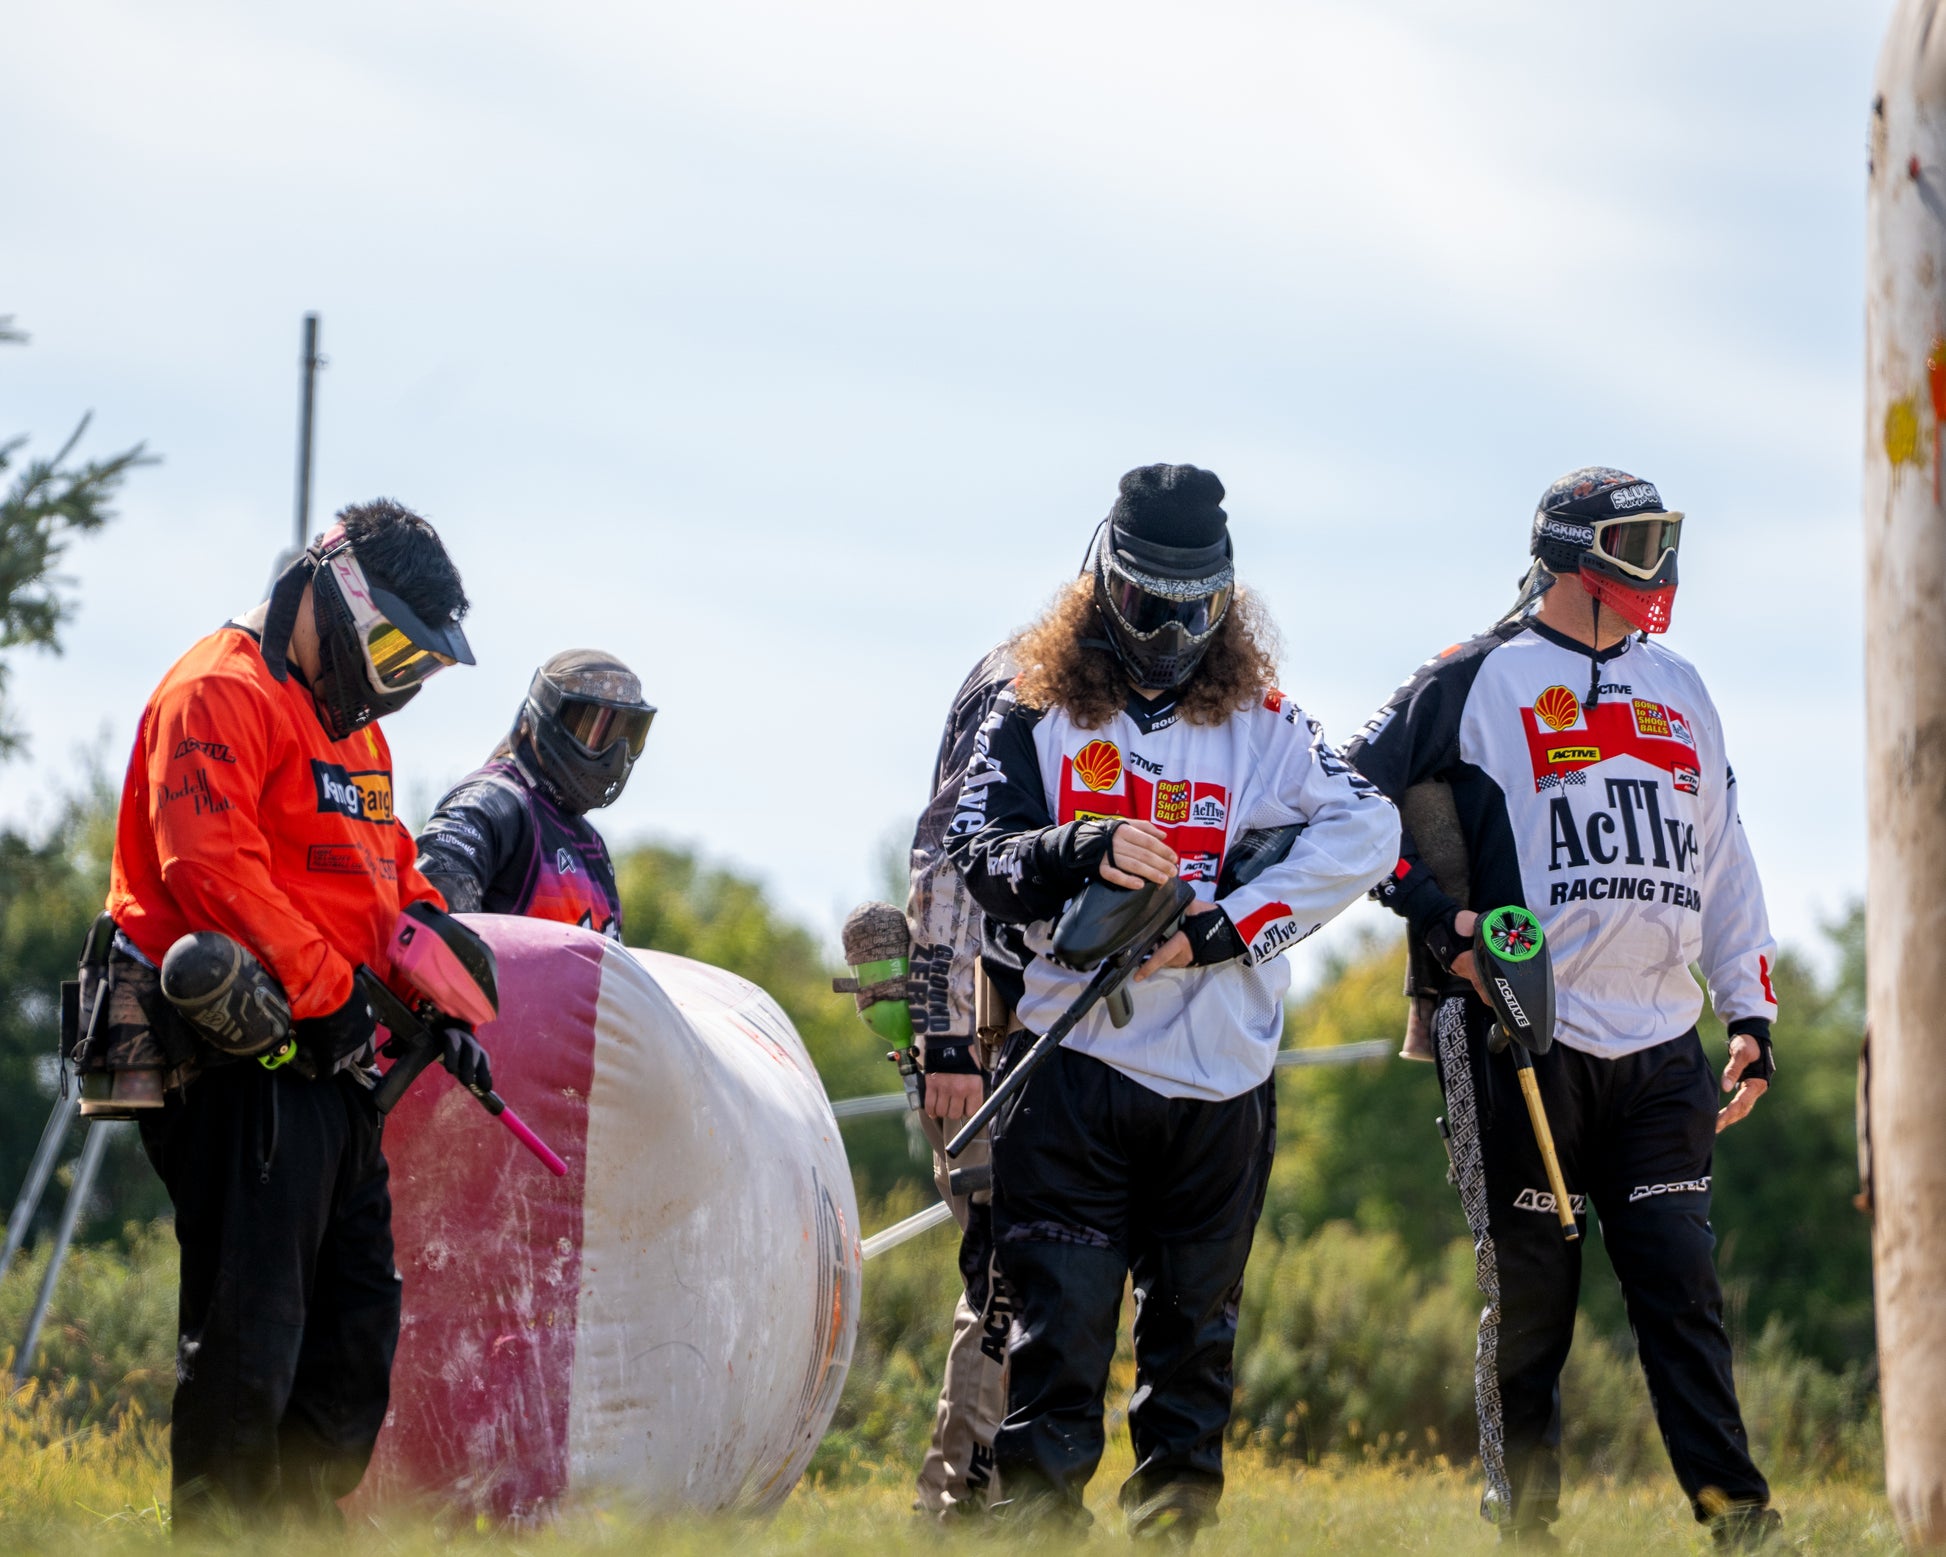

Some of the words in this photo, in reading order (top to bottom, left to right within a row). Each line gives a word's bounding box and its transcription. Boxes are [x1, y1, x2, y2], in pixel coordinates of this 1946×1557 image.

[1634, 700, 1658, 711] BORN
[1638, 716, 1667, 726] SHOOT
[1640, 724, 1668, 734] BALLS
[1552, 750, 1597, 760] ACTIVE
[1158, 782, 1187, 793] BORN
[1158, 791, 1169, 800] to
[1157, 800, 1189, 812] SHOOT
[1156, 810, 1187, 821] BALLS
[1550, 877, 1656, 906] RACING
[907, 942, 934, 1034] ZERO
[928, 943, 954, 1033] GROUND
[1495, 977, 1530, 1028] ACTIVE
